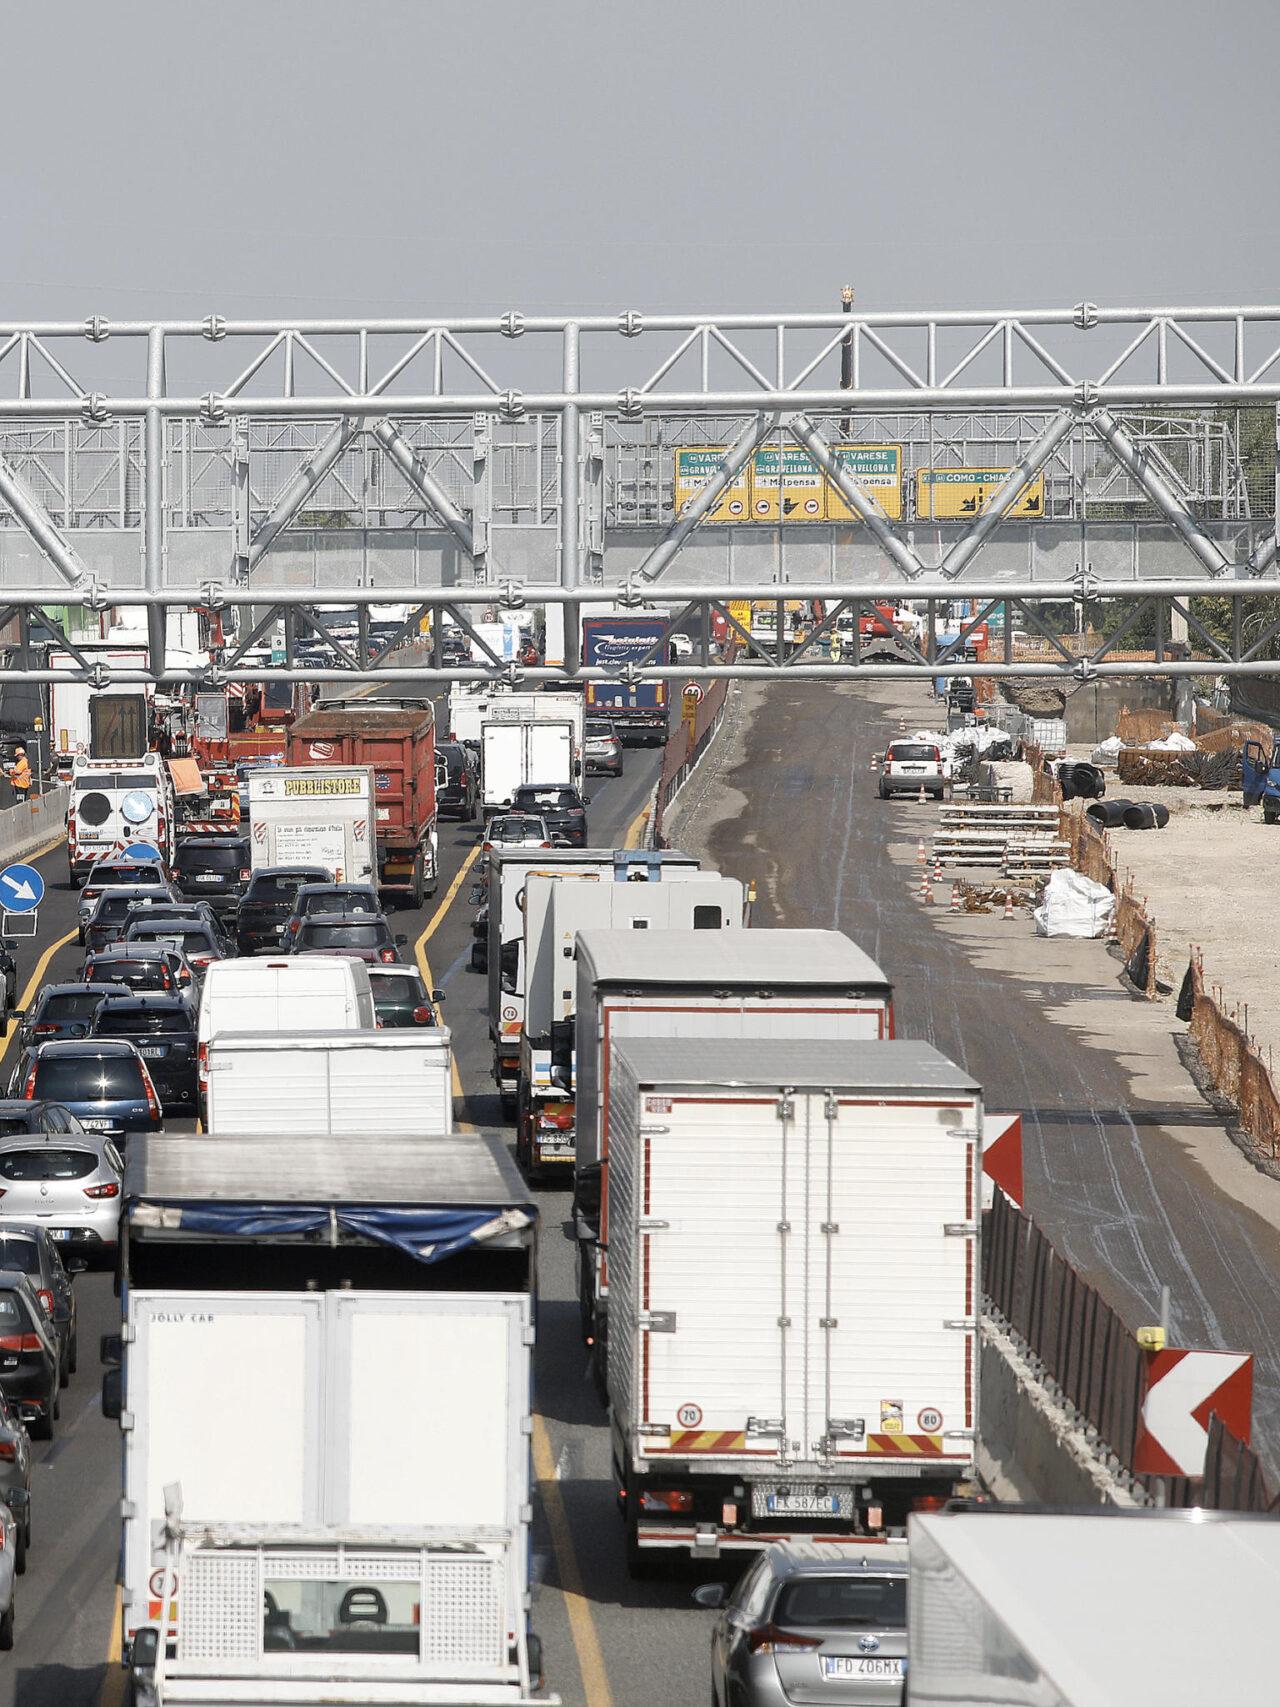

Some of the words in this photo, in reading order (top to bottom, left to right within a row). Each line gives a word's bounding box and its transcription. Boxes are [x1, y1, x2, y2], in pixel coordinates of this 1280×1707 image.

[851, 452, 888, 460] VARESE
[946, 473, 975, 482] COMO
[284, 778, 361, 796] PUBBLISTORE
[151, 1313, 185, 1323] JOLLY
[683, 1410, 696, 1421] 70
[775, 1497, 792, 1508] FK
[794, 1496, 832, 1508] 587EC
[836, 1659, 853, 1673] FD
[857, 1660, 900, 1674] 406MX
